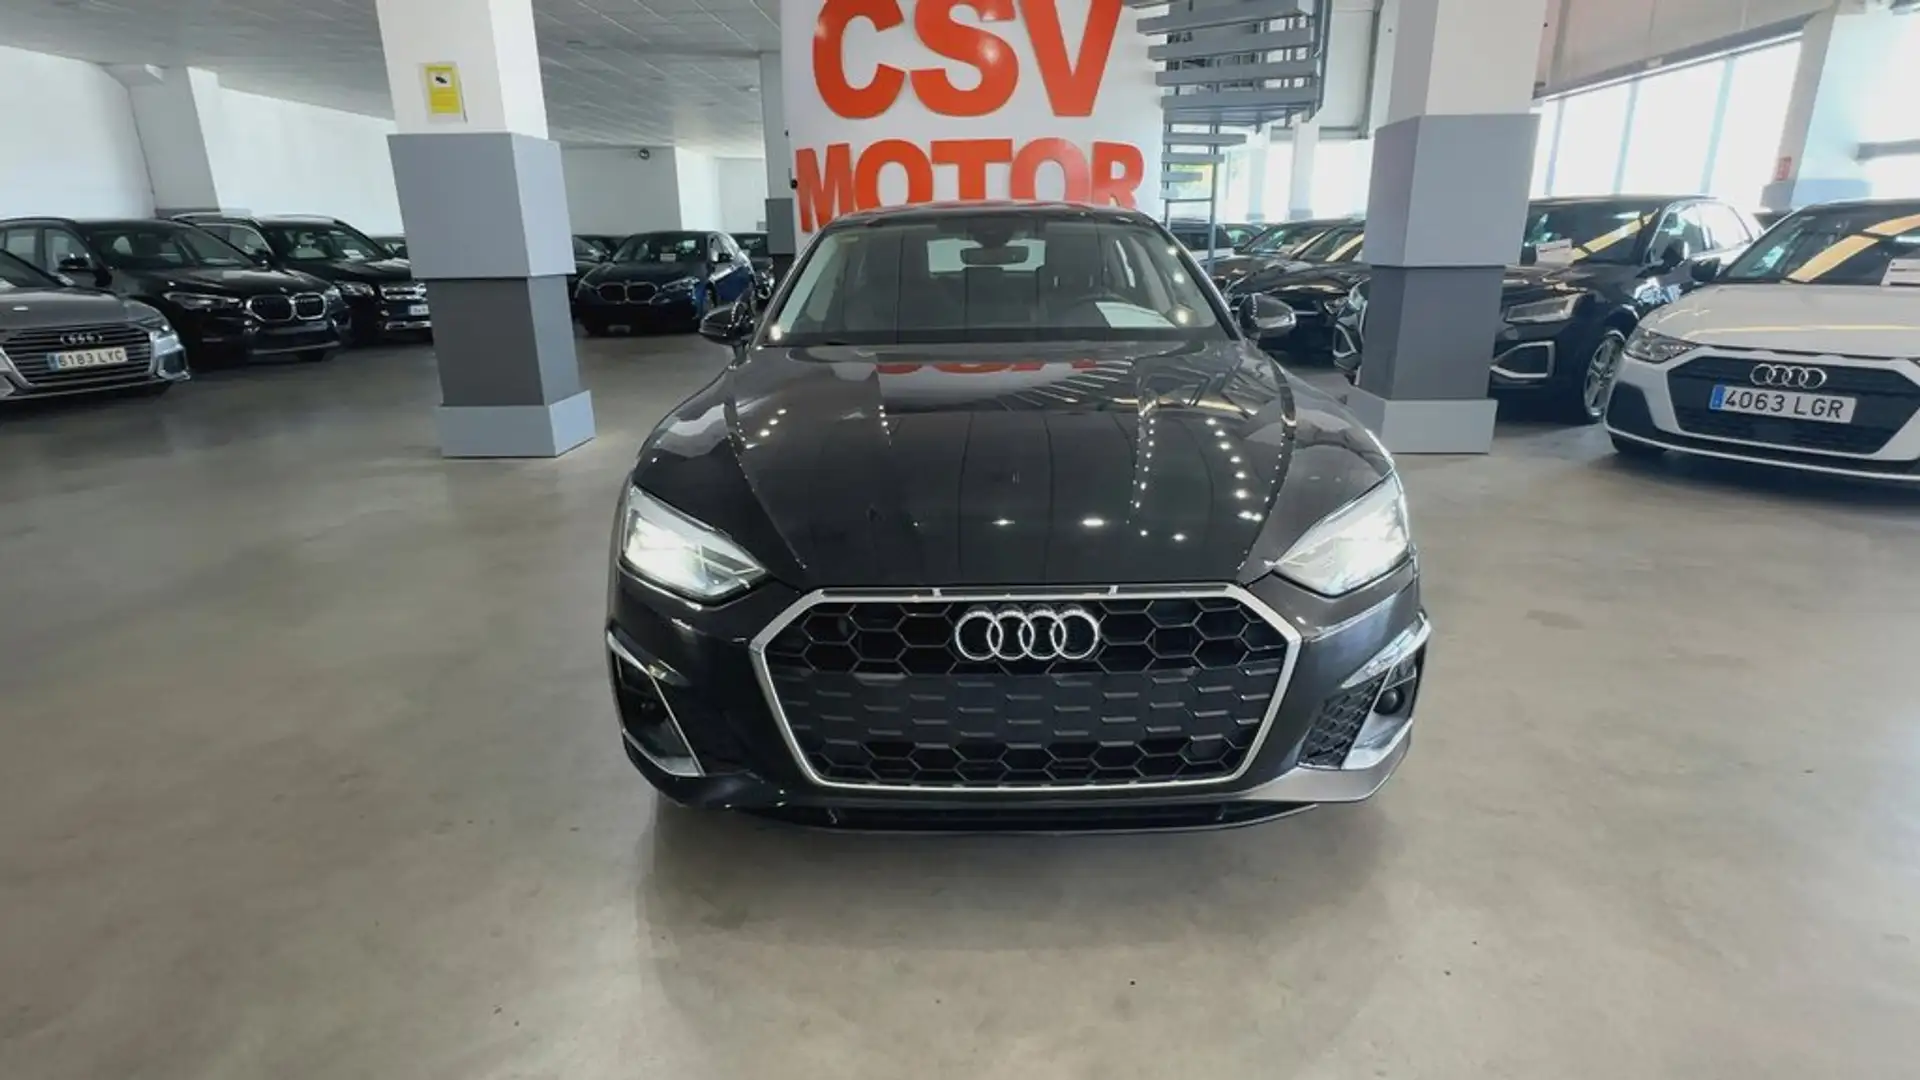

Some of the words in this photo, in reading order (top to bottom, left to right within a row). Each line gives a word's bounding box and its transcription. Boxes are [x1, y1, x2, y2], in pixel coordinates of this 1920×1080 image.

[813, 0, 1123, 119] CSV
[795, 137, 1145, 233] MOTOR
[1725, 390, 1785, 412] 4063
[1794, 395, 1844, 419] LGR
